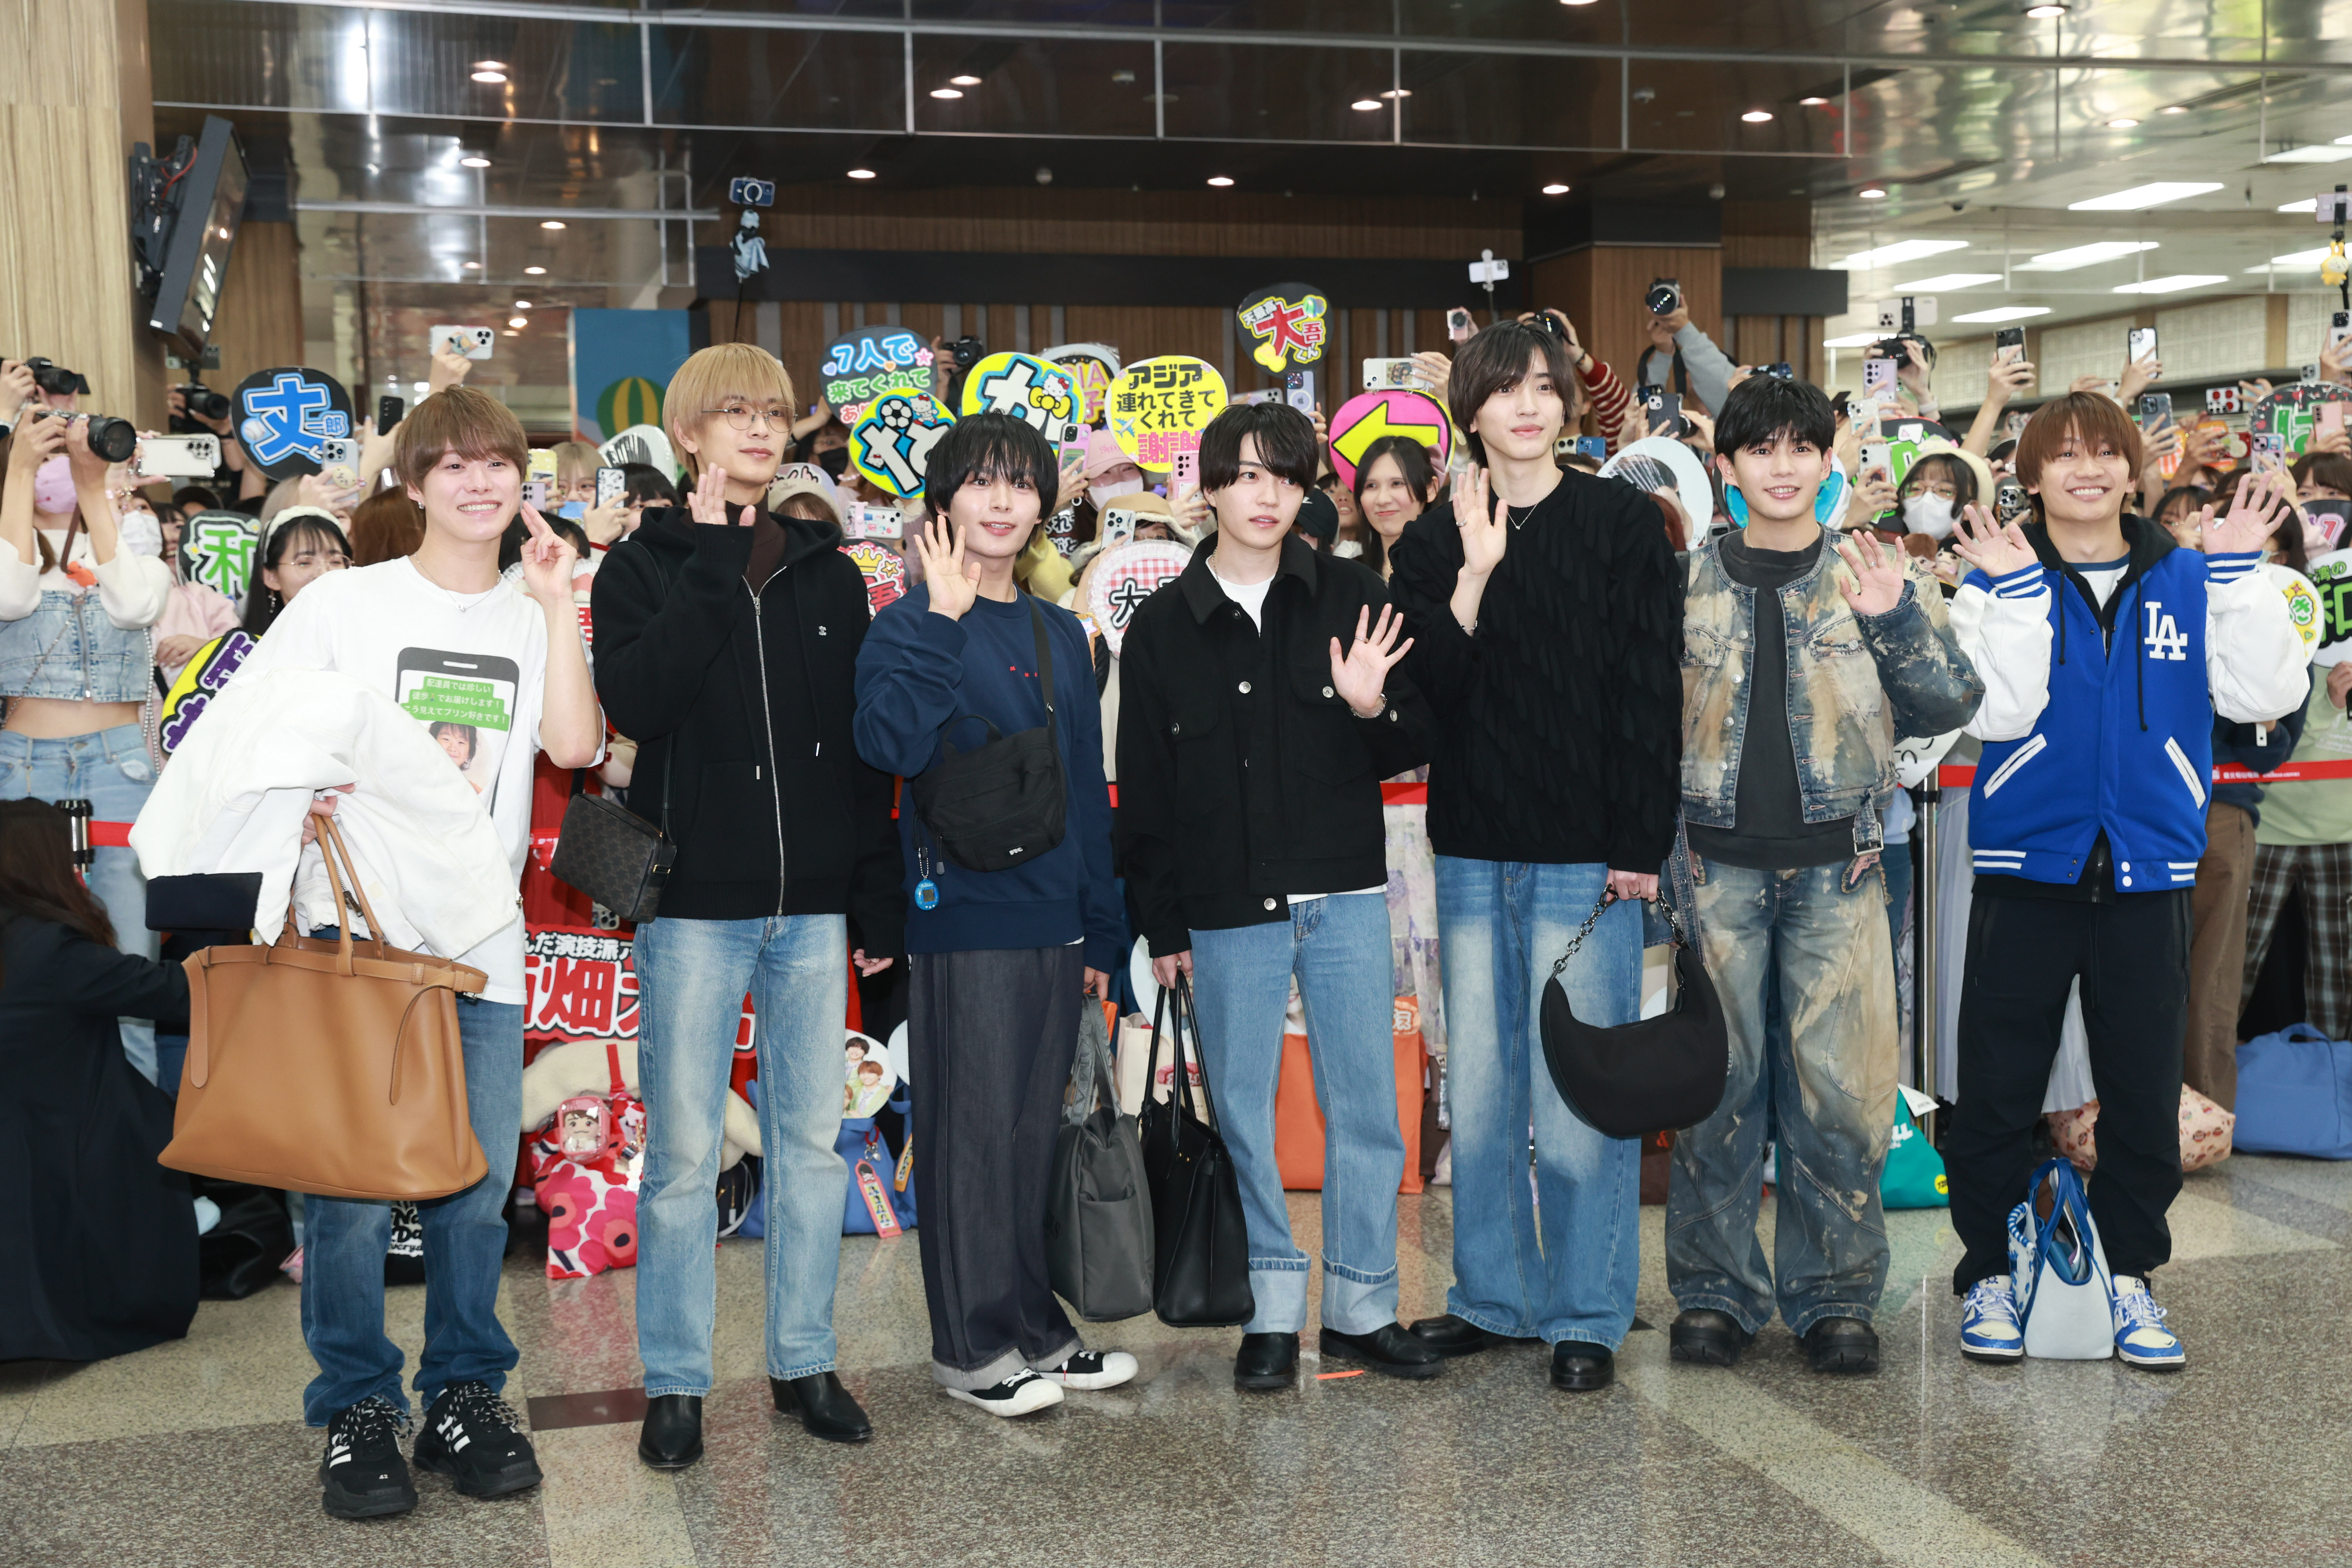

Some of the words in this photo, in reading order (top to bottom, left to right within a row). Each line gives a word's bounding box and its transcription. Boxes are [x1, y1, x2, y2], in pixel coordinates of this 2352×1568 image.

[1254, 302, 1313, 357] 大
[831, 334, 919, 374] 7人で
[827, 367, 931, 404] 来てくれて
[1128, 364, 1203, 390] アジア
[1117, 390, 1216, 412] 連れてきて
[248, 376, 328, 462] 丈
[840, 402, 871, 424] あ
[1140, 409, 1196, 429] くれて
[2144, 601, 2188, 661] LA
[412, 691, 428, 701] 徒歩
[426, 677, 491, 693] 配達員では珍しい
[404, 705, 506, 724] こう見えてプリン好きです！
[1009, 847, 1024, 856] FTC
